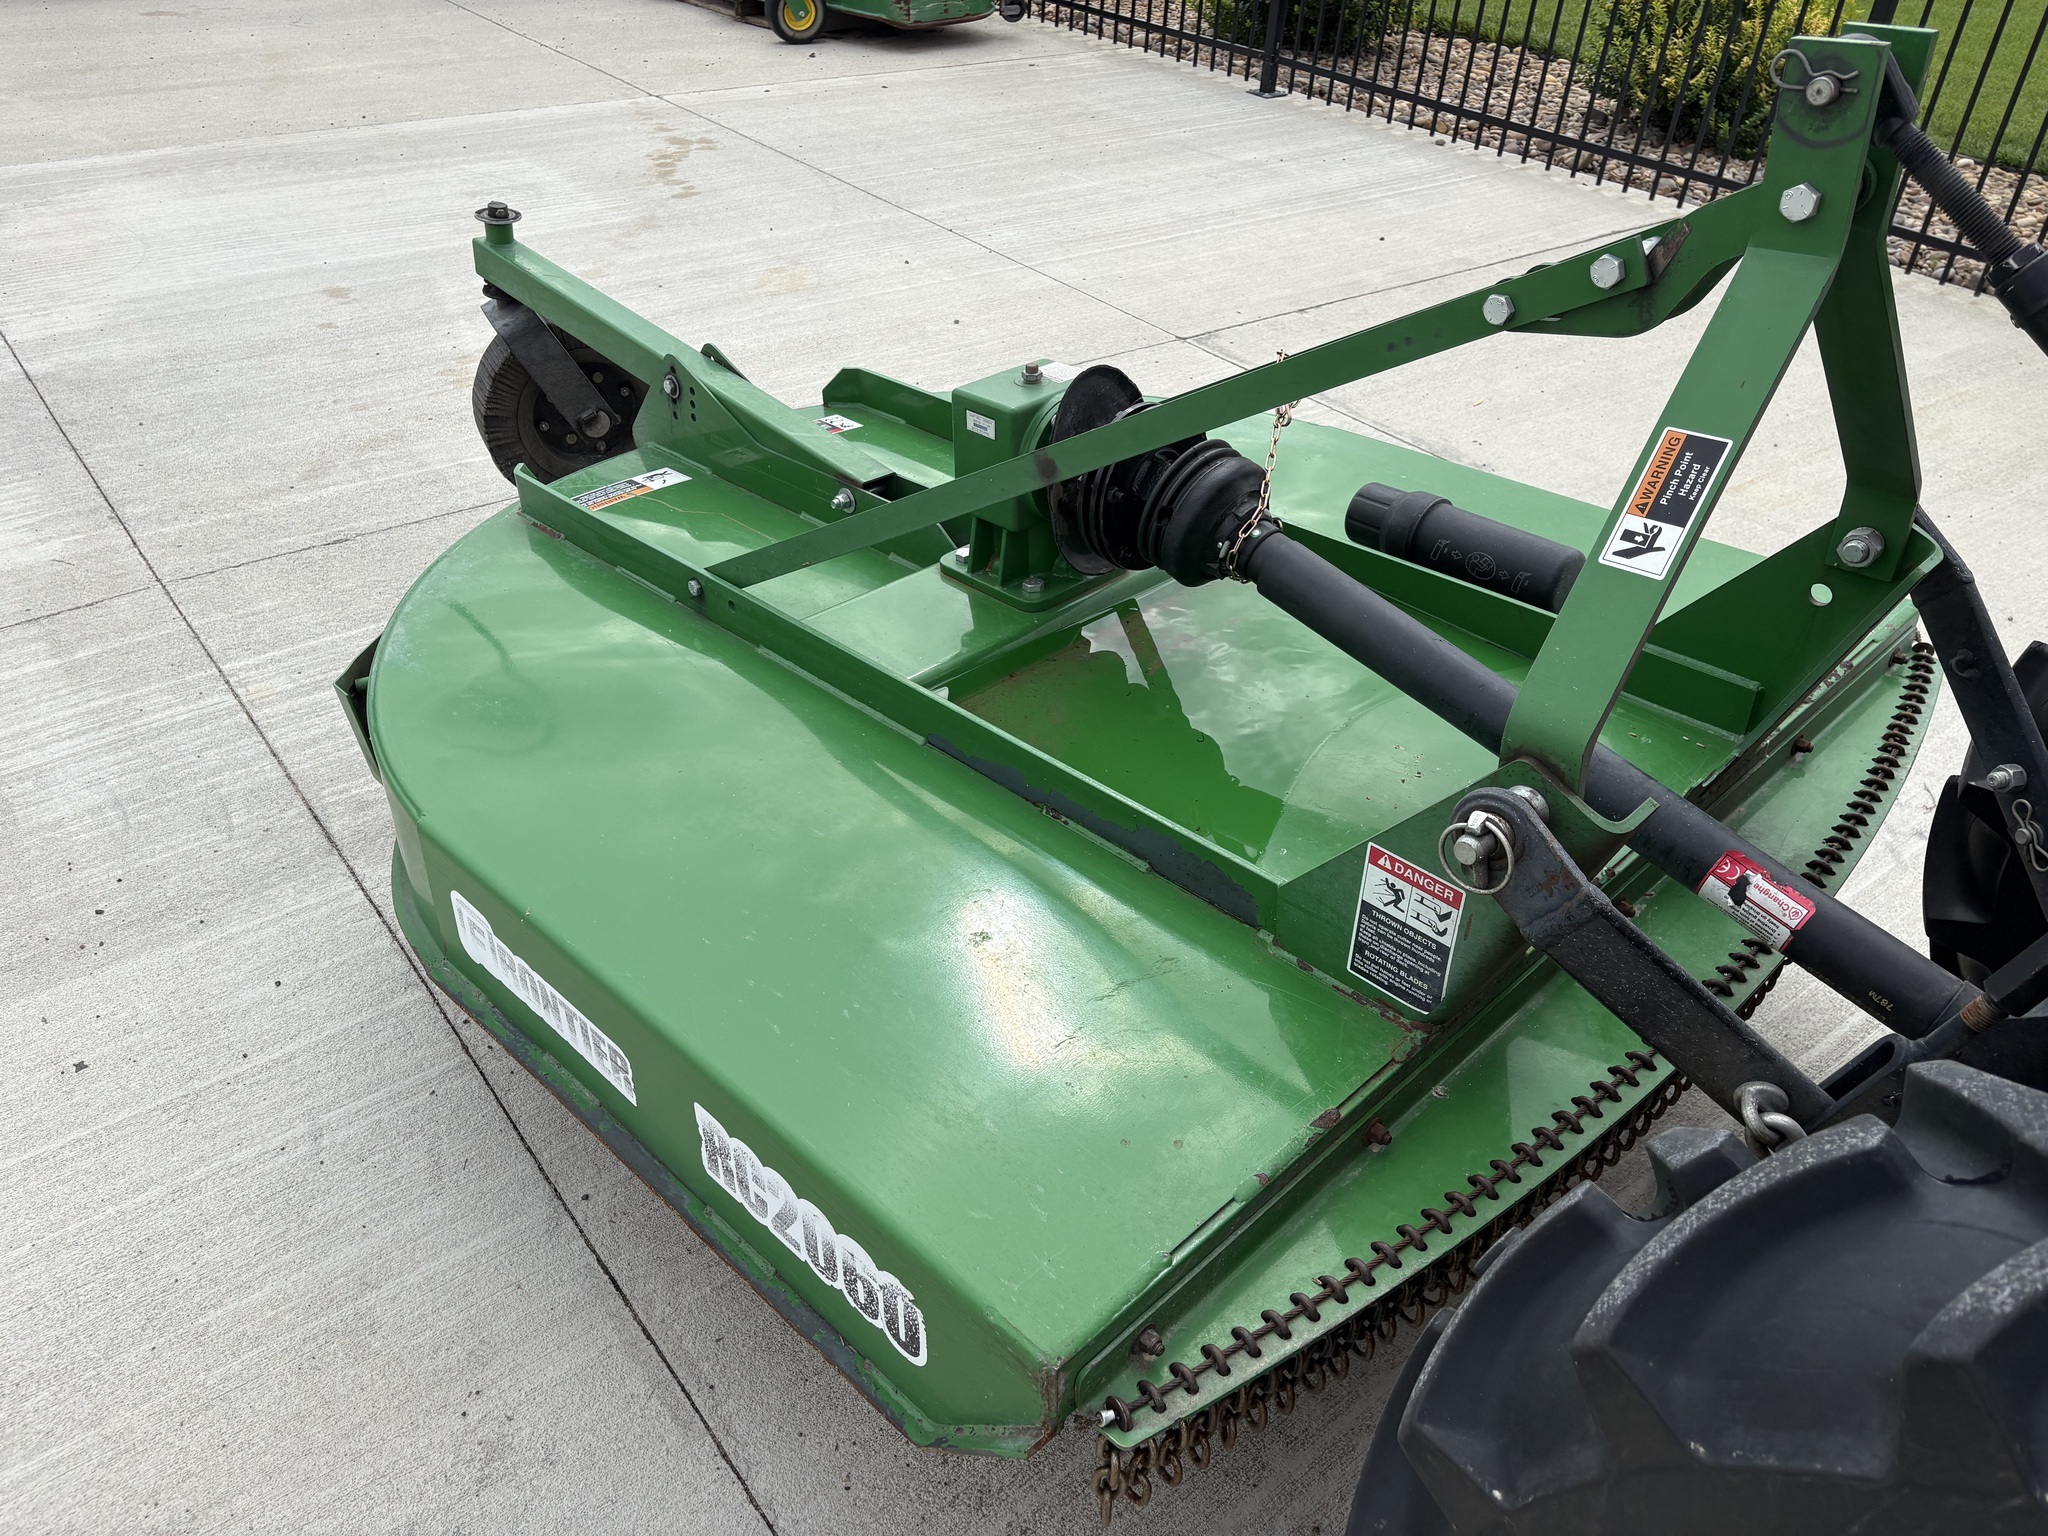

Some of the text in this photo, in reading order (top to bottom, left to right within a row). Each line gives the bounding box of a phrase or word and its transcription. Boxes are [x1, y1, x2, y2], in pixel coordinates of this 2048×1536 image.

[1640, 437, 1681, 500] WARNING
[1660, 451, 1694, 505] Pinch Point
[1678, 464, 1701, 496] Hazard
[1689, 466, 1711, 500] Keep Clear
[1395, 862, 1454, 902] DANGER
[1754, 883, 1789, 911] Changhe
[1372, 910, 1437, 950] THROWN OBJECTS
[1377, 928, 1386, 936] can
[1394, 937, 1411, 949] thrown
[1412, 947, 1435, 963] hundreds
[1412, 942, 1423, 951] near
[1365, 950, 1428, 990] ROTATING BLADES
[1404, 958, 1423, 972] opening
[1418, 961, 1441, 977] including
[1868, 990, 1895, 1012] 787M
[699, 1112, 925, 1358] RC2060
